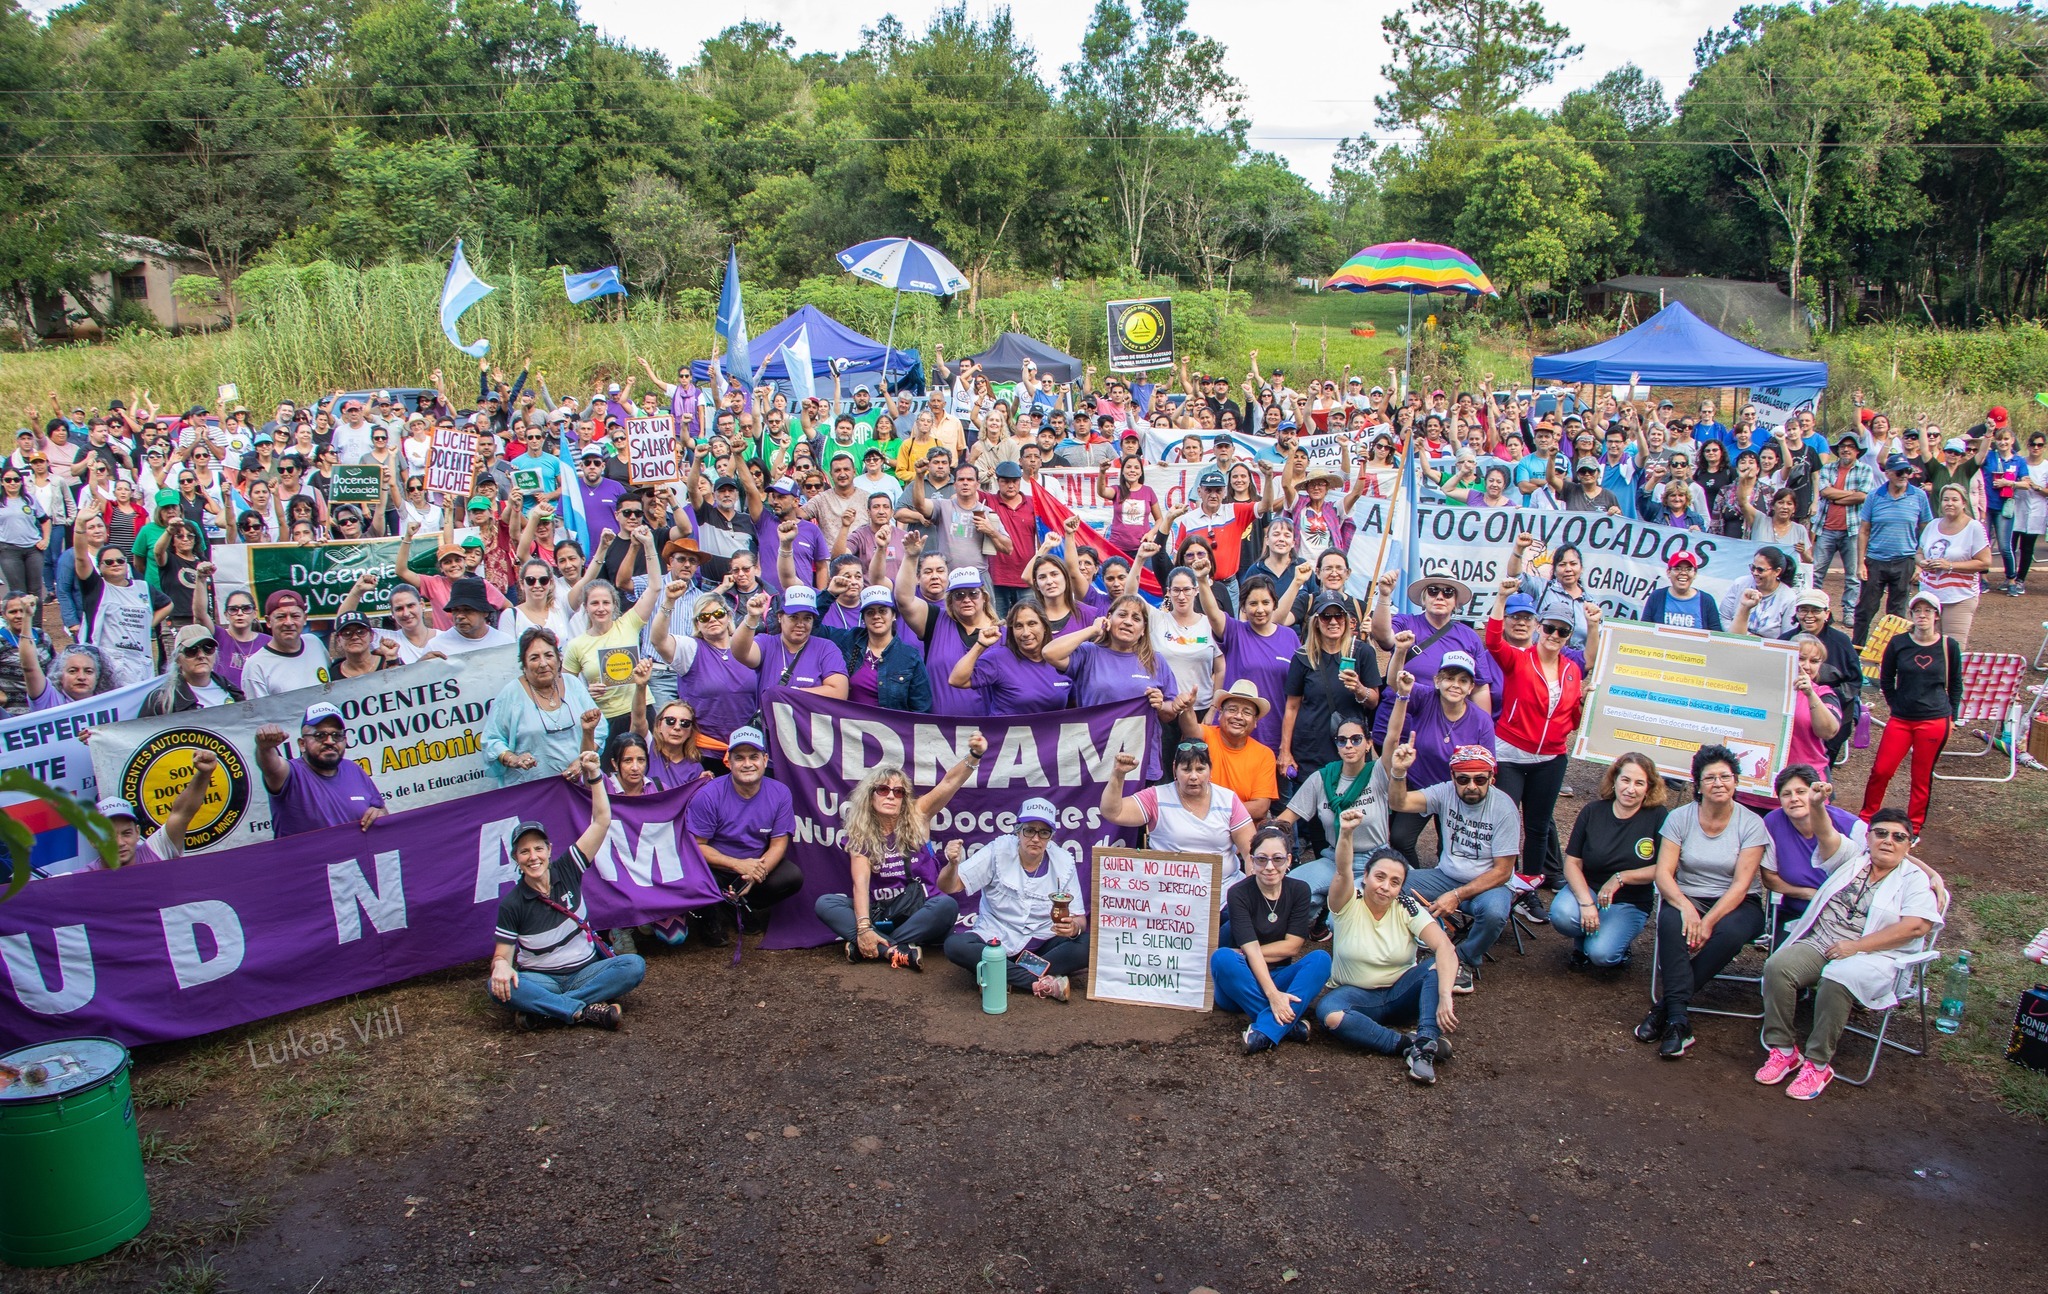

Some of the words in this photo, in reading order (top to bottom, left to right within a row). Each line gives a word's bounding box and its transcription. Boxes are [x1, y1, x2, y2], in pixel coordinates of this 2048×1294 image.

[628, 419, 648, 434] POR
[651, 418, 670, 433] UN
[433, 429, 479, 452] LUCHE
[430, 447, 476, 474] DOCENTE
[332, 474, 379, 485] Docencia
[427, 467, 474, 493] LUCHE
[630, 460, 677, 485] DIGNO
[332, 486, 339, 497] y
[339, 485, 379, 495] Vocación
[1362, 503, 1717, 570] ATOCONVOCADOS
[290, 562, 397, 587] Docencia
[311, 583, 391, 607] Vocció
[339, 612, 363, 627] FBI
[1618, 645, 1646, 656] Paramos
[1652, 650, 1664, 658] nos
[1640, 669, 1662, 679] salario
[1662, 673, 1675, 682] que
[1675, 674, 1694, 684] cubra
[1695, 677, 1705, 686] las
[340, 678, 461, 721] OCENTES
[1608, 686, 1621, 695] Por
[1621, 688, 1648, 699] resolver
[1647, 691, 1657, 701] las
[1657, 693, 1689, 707] carencias
[1688, 700, 1713, 711] básicas
[1713, 704, 1724, 712] de
[1730, 707, 1766, 719] educación.
[1645, 715, 1658, 723] con
[1658, 717, 1668, 725] los
[1668, 717, 1699, 731] docentes
[1700, 724, 1710, 732] de
[150, 732, 244, 779] AUTOCONVOCADOS
[771, 700, 1148, 789] UDNAM
[395, 782, 412, 798] de
[412, 779, 426, 794] la
[1103, 856, 1134, 872] QUIEN
[1144, 861, 1159, 875] NO
[1164, 863, 1201, 879] LUCHA
[1102, 876, 1121, 890] POR
[1128, 878, 1150, 891] SUS
[1158, 881, 1208, 898] DERECHOS
[1101, 895, 1151, 913] RENUNCIA
[1160, 902, 1168, 915] A
[1174, 904, 1191, 917] SU
[1100, 914, 1138, 929] PROPIA
[1146, 918, 1195, 934] LIBERTAD
[1115, 931, 1137, 954] ¡EL
[1142, 933, 1193, 951] SILENCIO
[1124, 953, 1142, 968] NO
[1147, 954, 1162, 967] ES
[1166, 955, 1179, 970] MI
[1126, 971, 1181, 994] IDIOMA!
[2021, 1027, 2036, 1038] CADA
